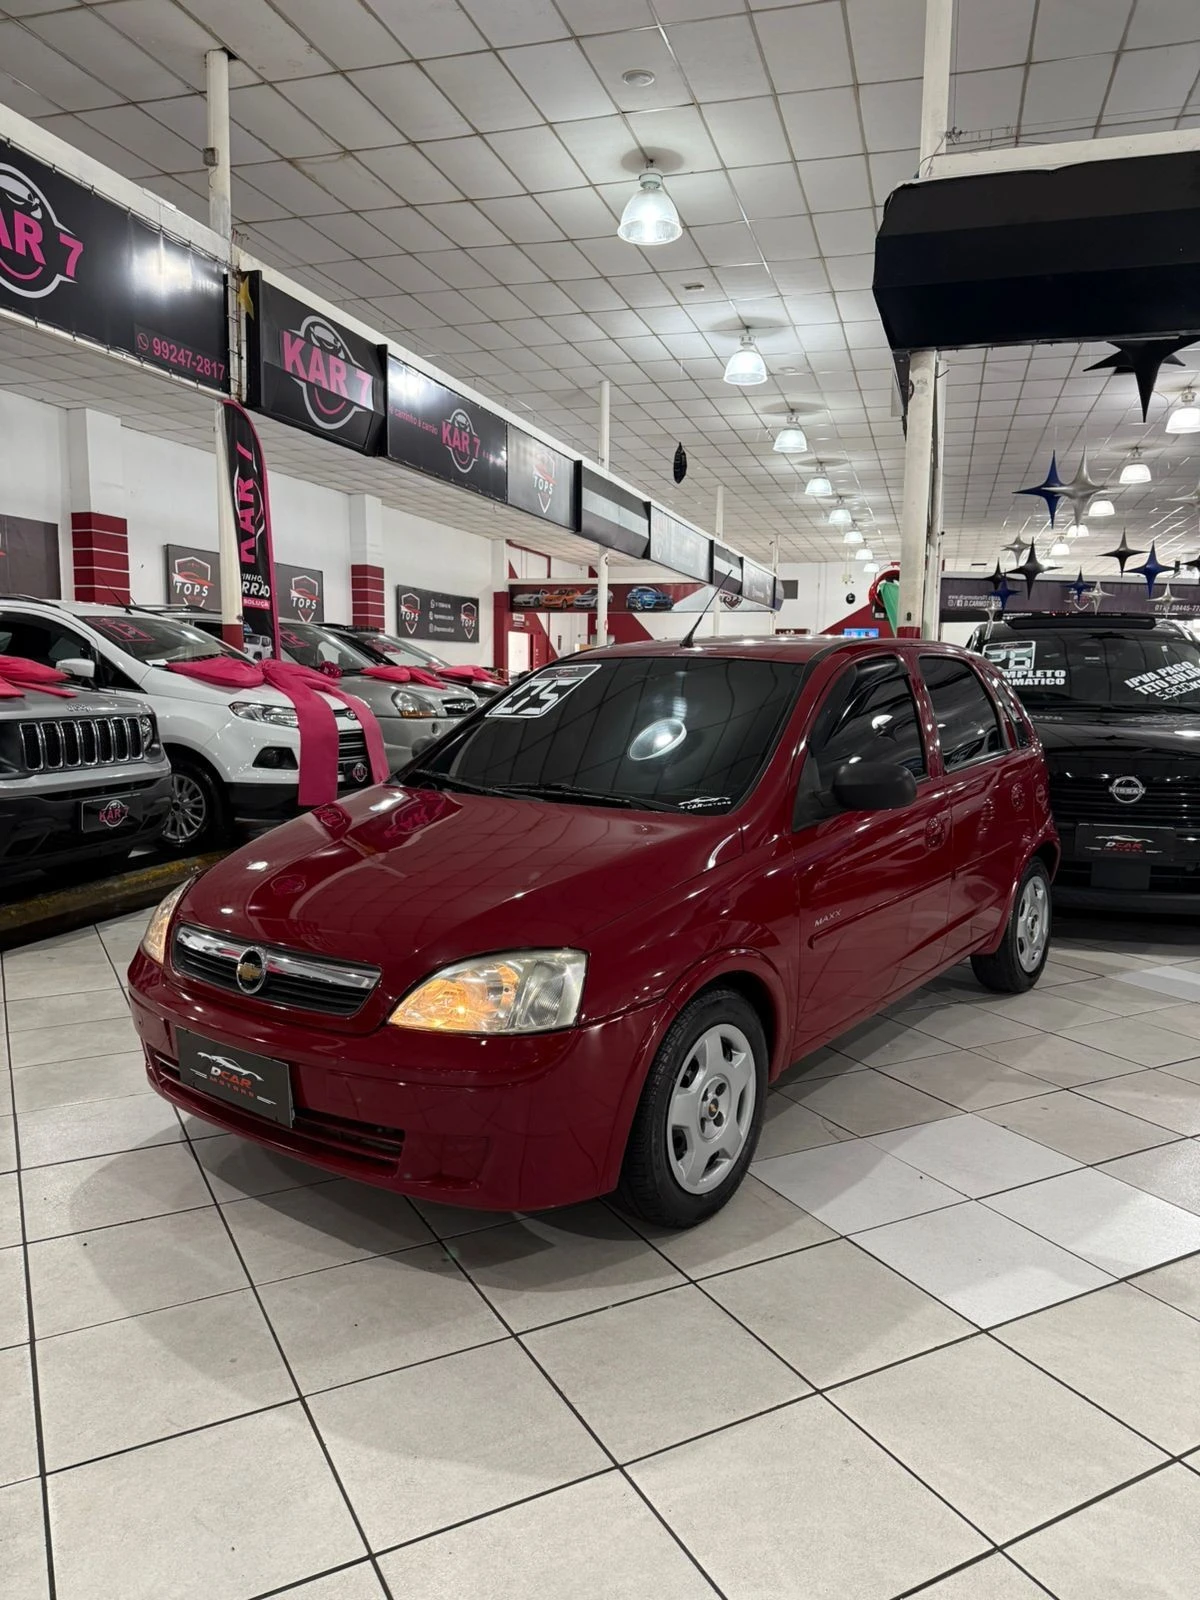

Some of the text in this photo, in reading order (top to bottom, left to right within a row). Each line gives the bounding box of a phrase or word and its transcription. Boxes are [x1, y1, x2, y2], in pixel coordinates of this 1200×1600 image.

[59, 231, 84, 278] 7
[152, 337, 225, 380] 99247-2817
[283, 329, 373, 407] KAR 7
[442, 420, 480, 458] KAR 7
[533, 475, 553, 495] TOPS
[175, 582, 209, 597] TOPS
[292, 597, 317, 610] TOPS
[401, 610, 419, 622] TOPS
[461, 618, 476, 628] TOPS
[1124, 660, 1195, 688] IPVA PAGO
[1134, 679, 1170, 695] TETO
[1108, 787, 1147, 795] NISSAN
[98, 807, 122, 823] KAR
[814, 909, 842, 928] MAXX
[211, 1066, 252, 1089] DCAR
